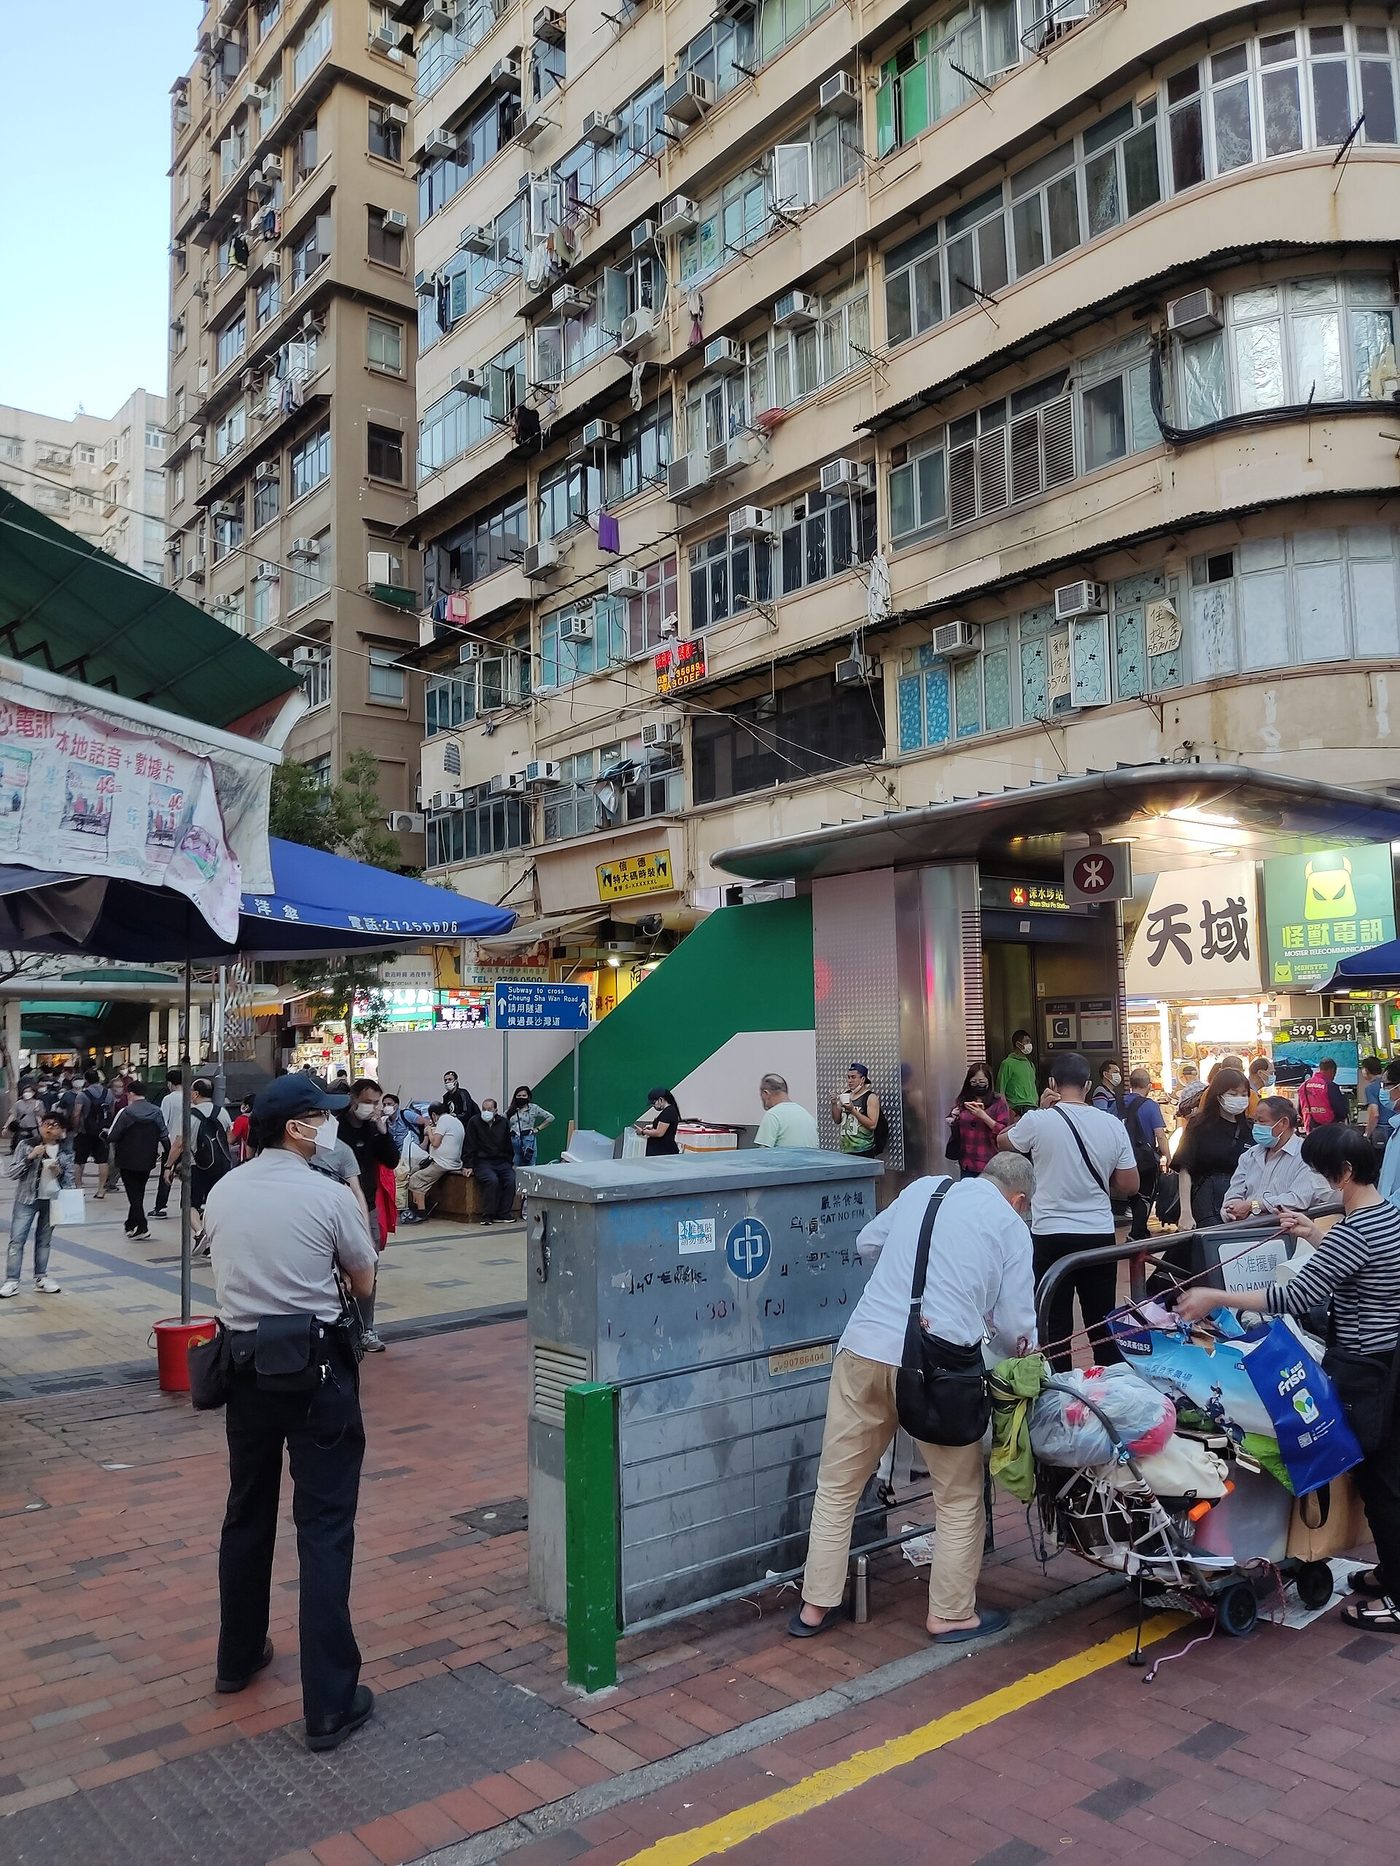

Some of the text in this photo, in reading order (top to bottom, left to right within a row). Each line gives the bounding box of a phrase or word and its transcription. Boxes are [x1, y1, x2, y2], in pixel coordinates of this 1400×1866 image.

[1146, 896, 1250, 967] 天域
[1282, 919, 1384, 948] 怪獸電訊
[508, 986, 532, 994] Subway
[508, 994, 531, 1002] Cheung
[508, 1003, 543, 1014] 請用隧道
[508, 1016, 560, 1026] 橫過長沙灣道
[821, 1213, 836, 1224] EAT
[837, 1211, 850, 1221] NO
[1233, 1254, 1278, 1274] 不准擺賣
